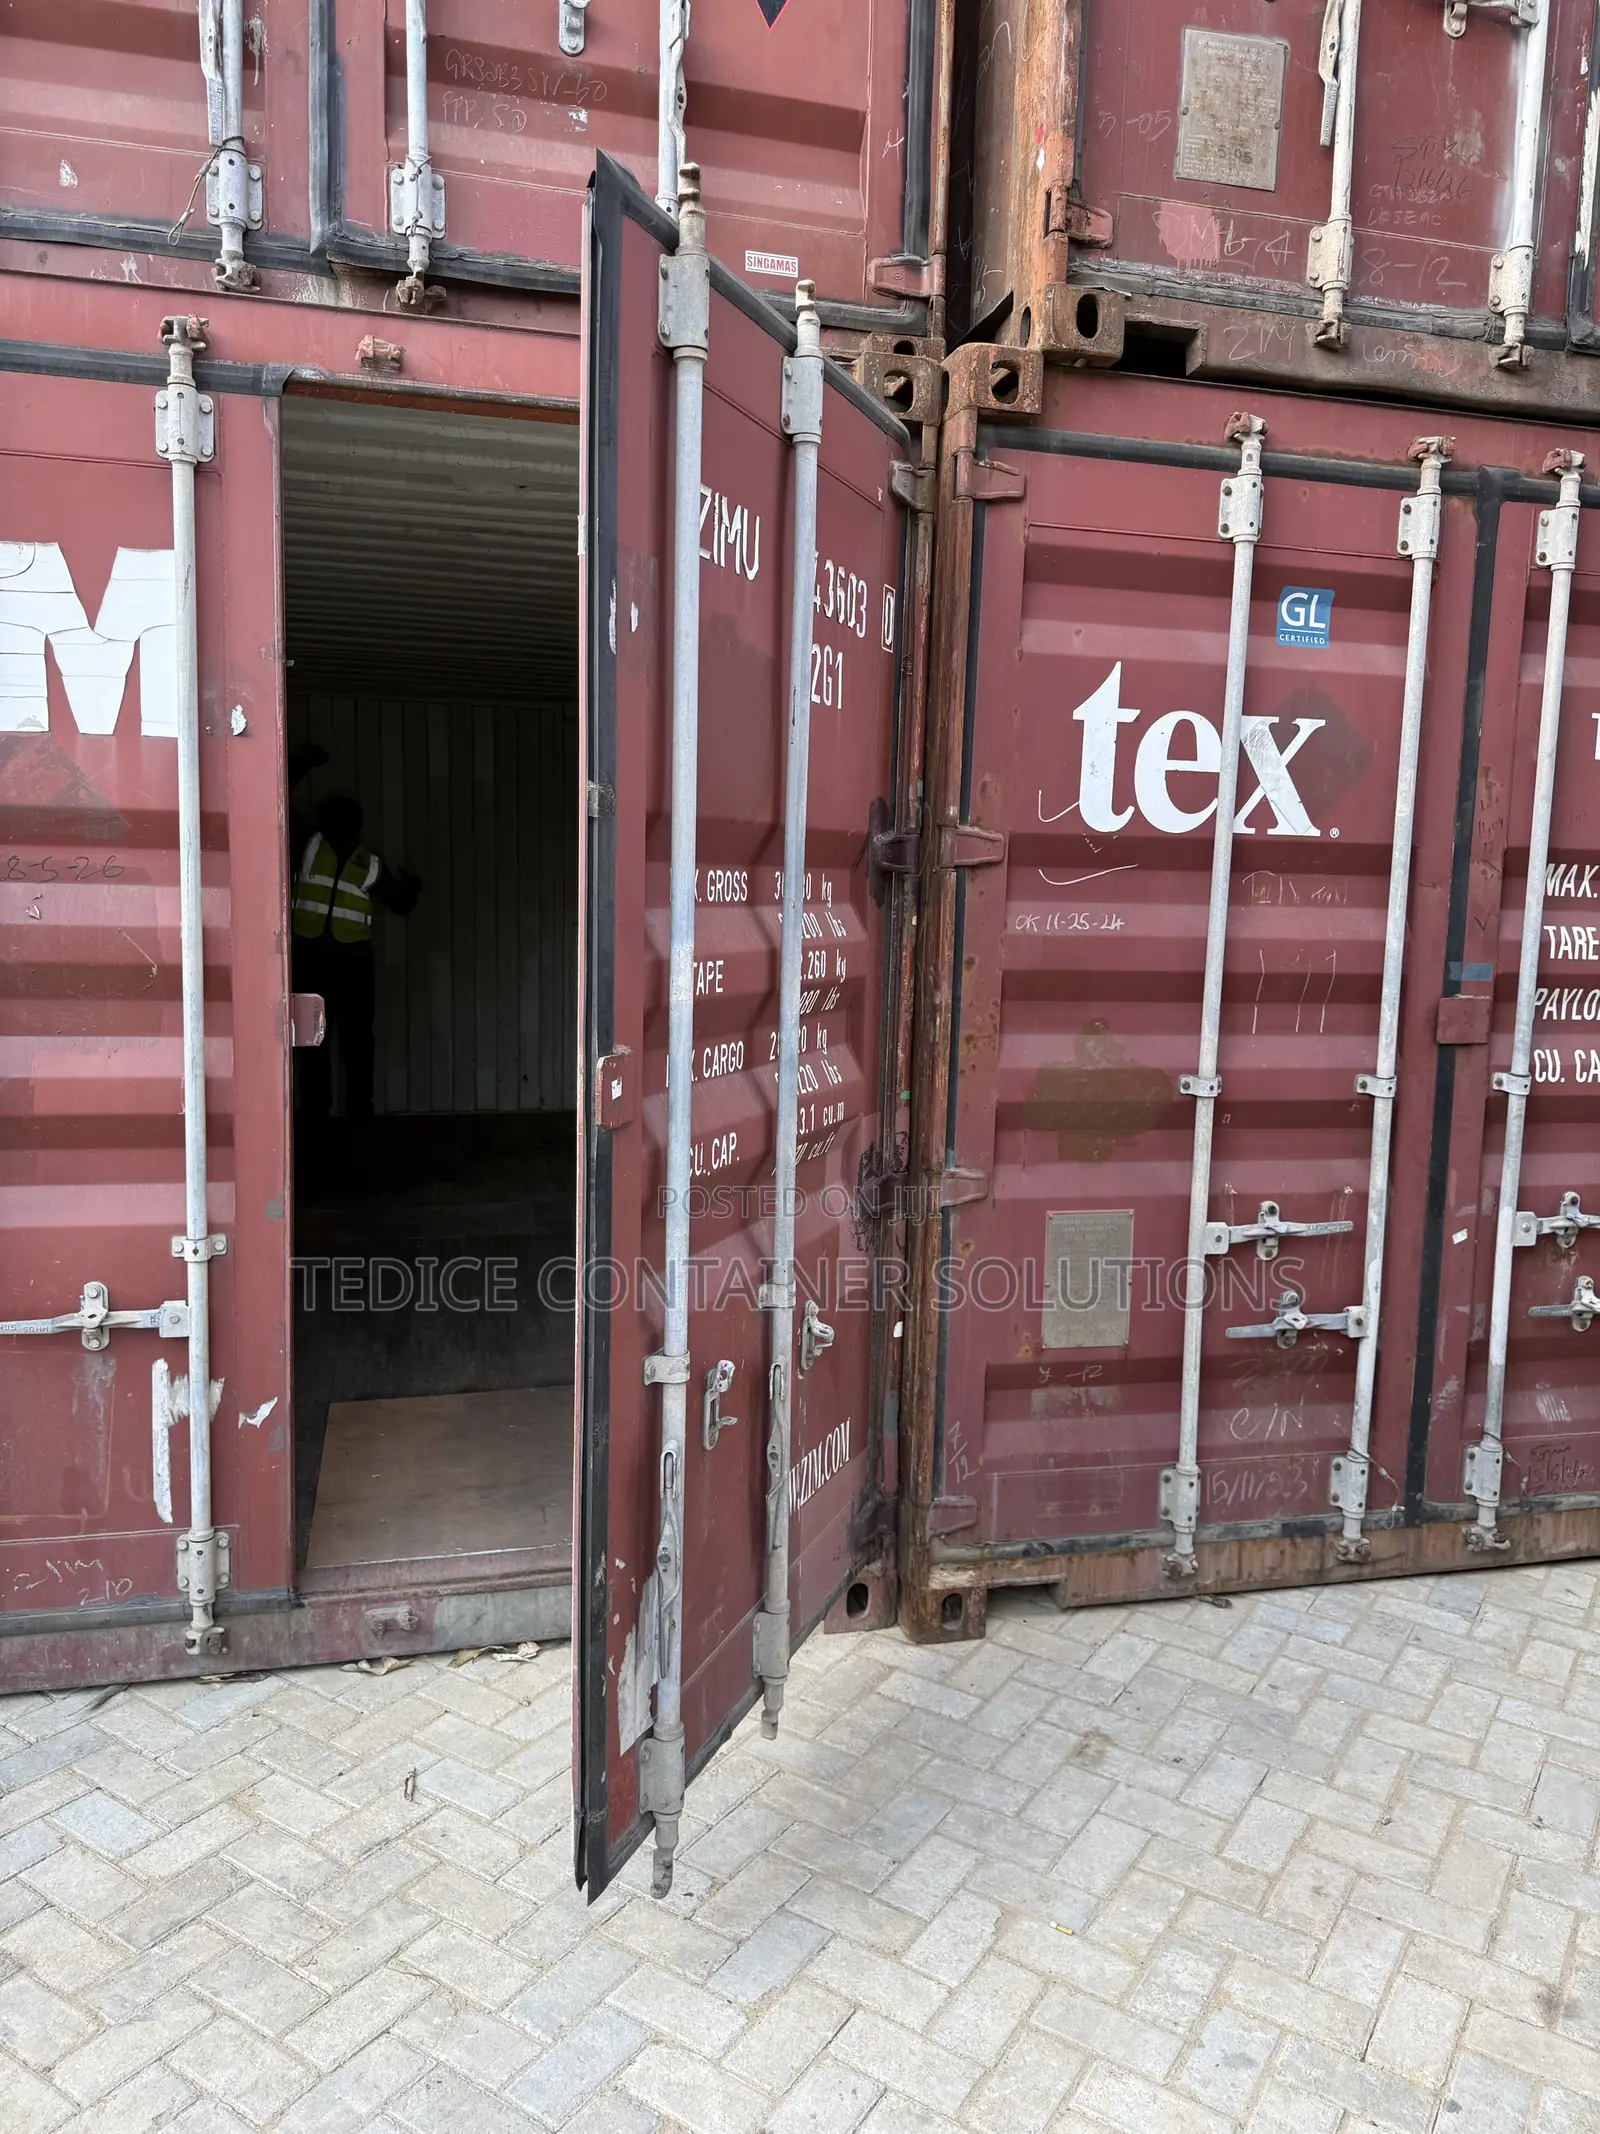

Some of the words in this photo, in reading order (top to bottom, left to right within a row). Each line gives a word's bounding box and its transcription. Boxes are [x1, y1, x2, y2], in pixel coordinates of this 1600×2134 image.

[746, 255, 797, 273] SINGAMAS
[1281, 592, 1327, 629] GL
[1279, 633, 1326, 645] CERTIFIED
[1073, 661, 1327, 837] tex
[706, 869, 748, 903] GROSS
[821, 873, 832, 908] kg
[825, 911, 847, 938] lbs
[1543, 925, 1600, 960] TARE
[836, 948, 847, 984] kg
[821, 986, 841, 1012] lbs
[702, 1040, 744, 1079] CARGO
[816, 1022, 828, 1056] kg
[1534, 1049, 1566, 1083] CU.
[820, 1059, 843, 1085] lbs
[823, 1101, 845, 1127] cu.m
[711, 1131, 741, 1171] CAP.
